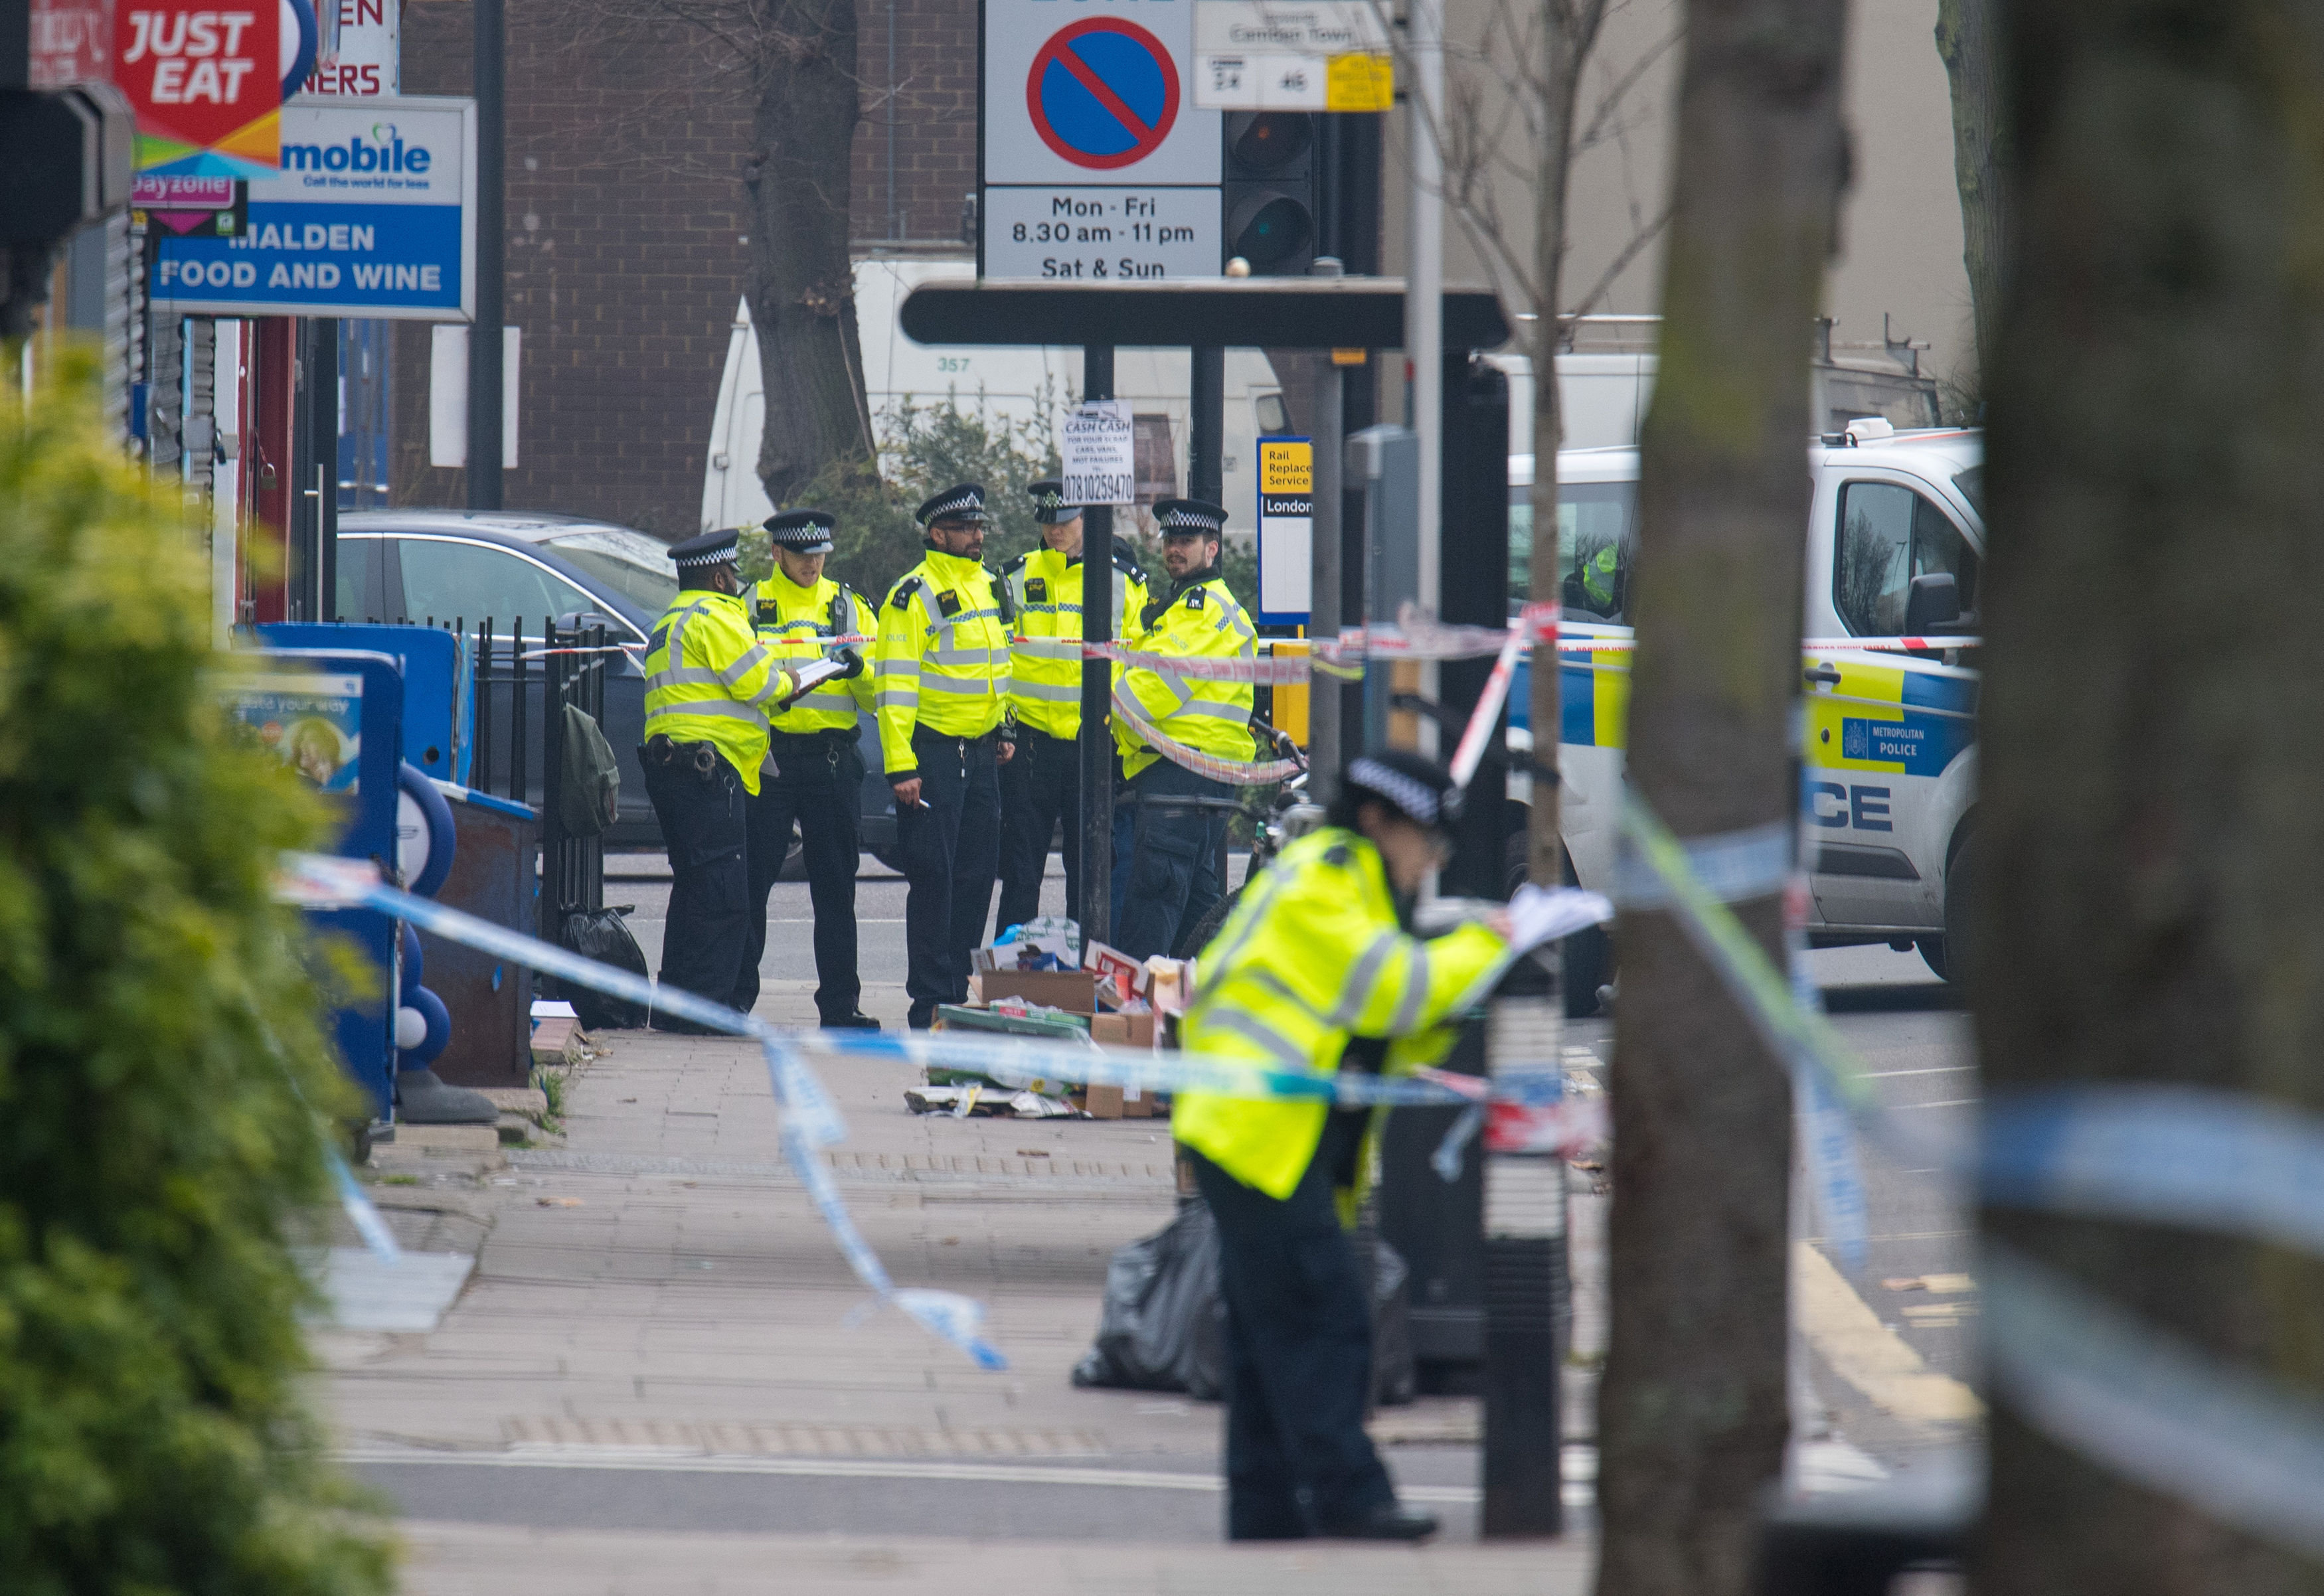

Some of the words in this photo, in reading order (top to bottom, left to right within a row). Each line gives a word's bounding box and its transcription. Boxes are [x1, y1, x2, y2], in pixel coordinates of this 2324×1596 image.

[124, 11, 255, 63] JUST
[151, 58, 254, 104] EAT
[282, 135, 430, 173] mobile
[1052, 197, 1102, 216] Mon
[1125, 197, 1155, 216] Fri
[228, 222, 374, 251] MALDEN
[1013, 222, 1070, 244] 8.30
[1076, 226, 1112, 243] am
[1132, 222, 1151, 242] 11
[1159, 226, 1194, 246] pm
[160, 260, 257, 288] FOOD
[268, 262, 341, 289] AND
[353, 263, 442, 291] WINE
[1042, 258, 1083, 278] Sat
[1093, 258, 1108, 278] &
[1118, 258, 1165, 278] Sun
[937, 357, 970, 372] 357
[1066, 421, 1096, 434] CASH
[1098, 421, 1130, 433] CASH
[1269, 451, 1289, 460] Rail
[1064, 474, 1133, 501] 07810259470
[1269, 475, 1309, 485] Service
[1267, 499, 1313, 513] London
[1872, 726, 1924, 740] METROPOLITAN
[1880, 742, 1918, 756] POLICE
[1803, 781, 1893, 832] CE
